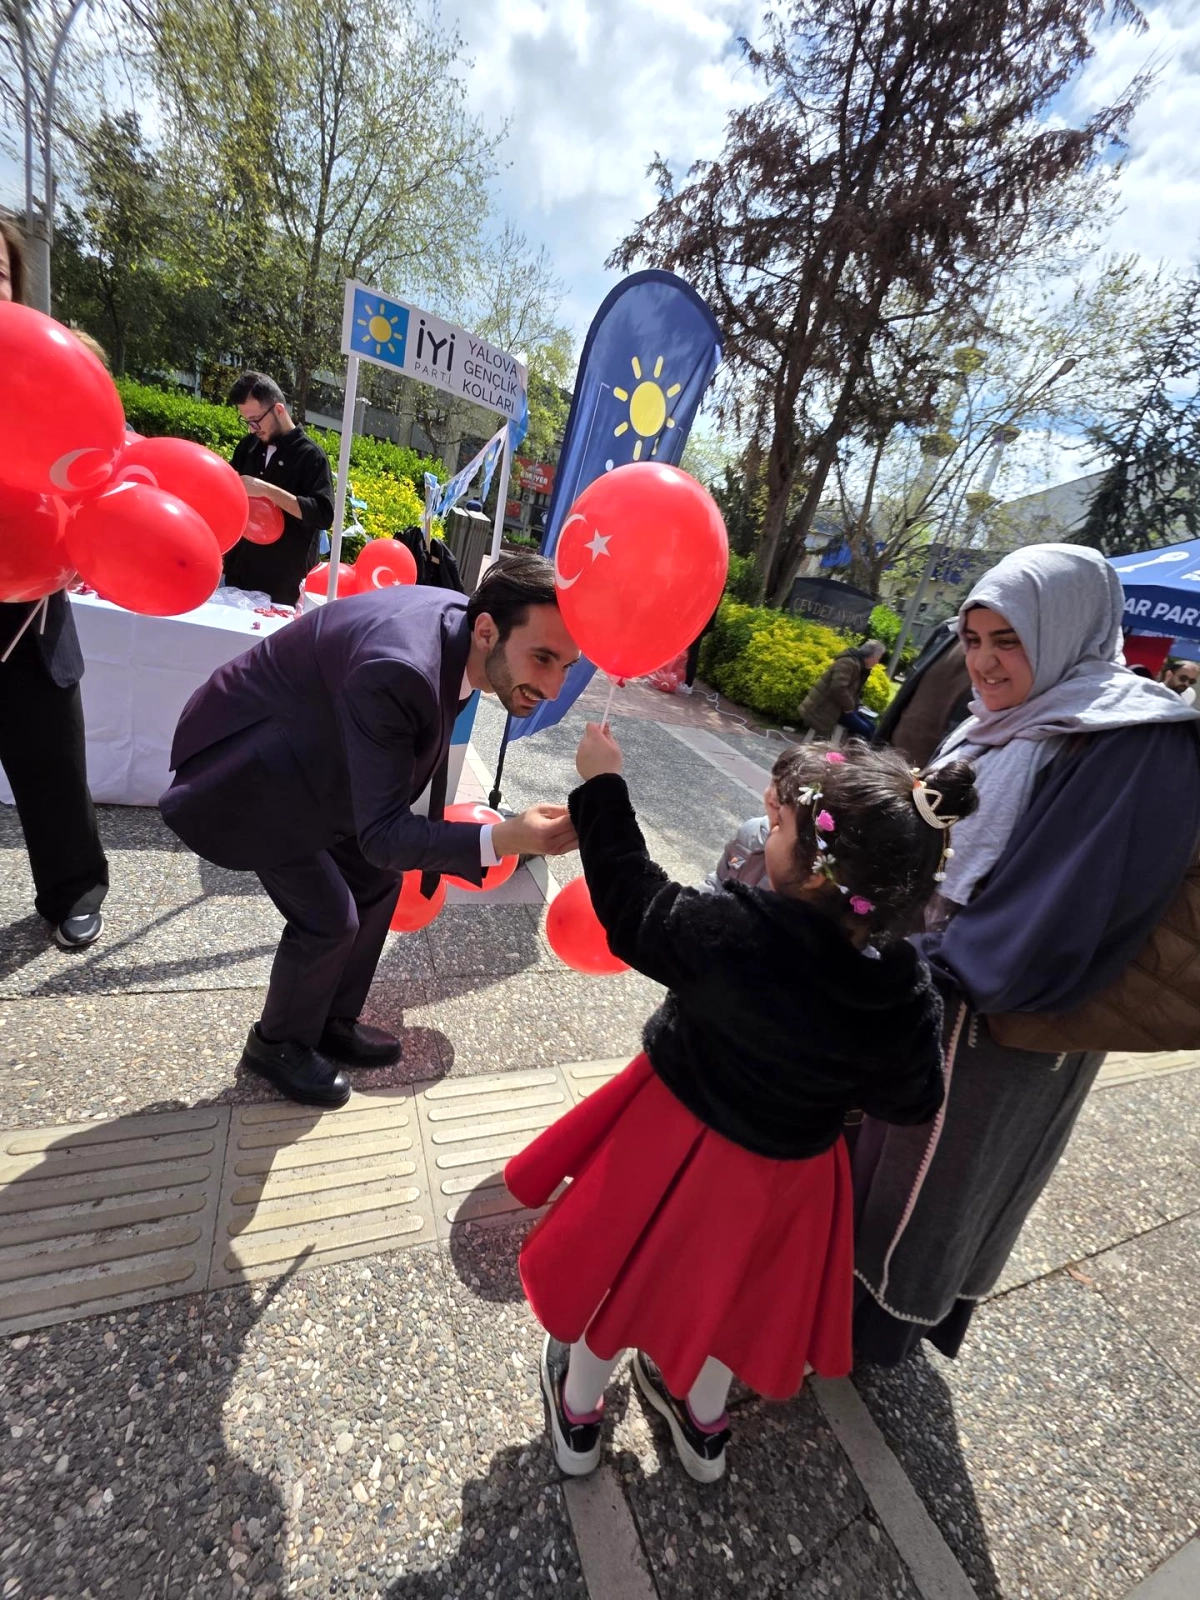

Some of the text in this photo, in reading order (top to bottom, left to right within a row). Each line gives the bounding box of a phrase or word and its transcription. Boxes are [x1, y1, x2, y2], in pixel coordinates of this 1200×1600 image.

[469, 339, 518, 376] YALOVA
[462, 379, 514, 413] KOLLARI
[464, 360, 518, 397] GENÇLİK
[1151, 602, 1200, 627] PAR
